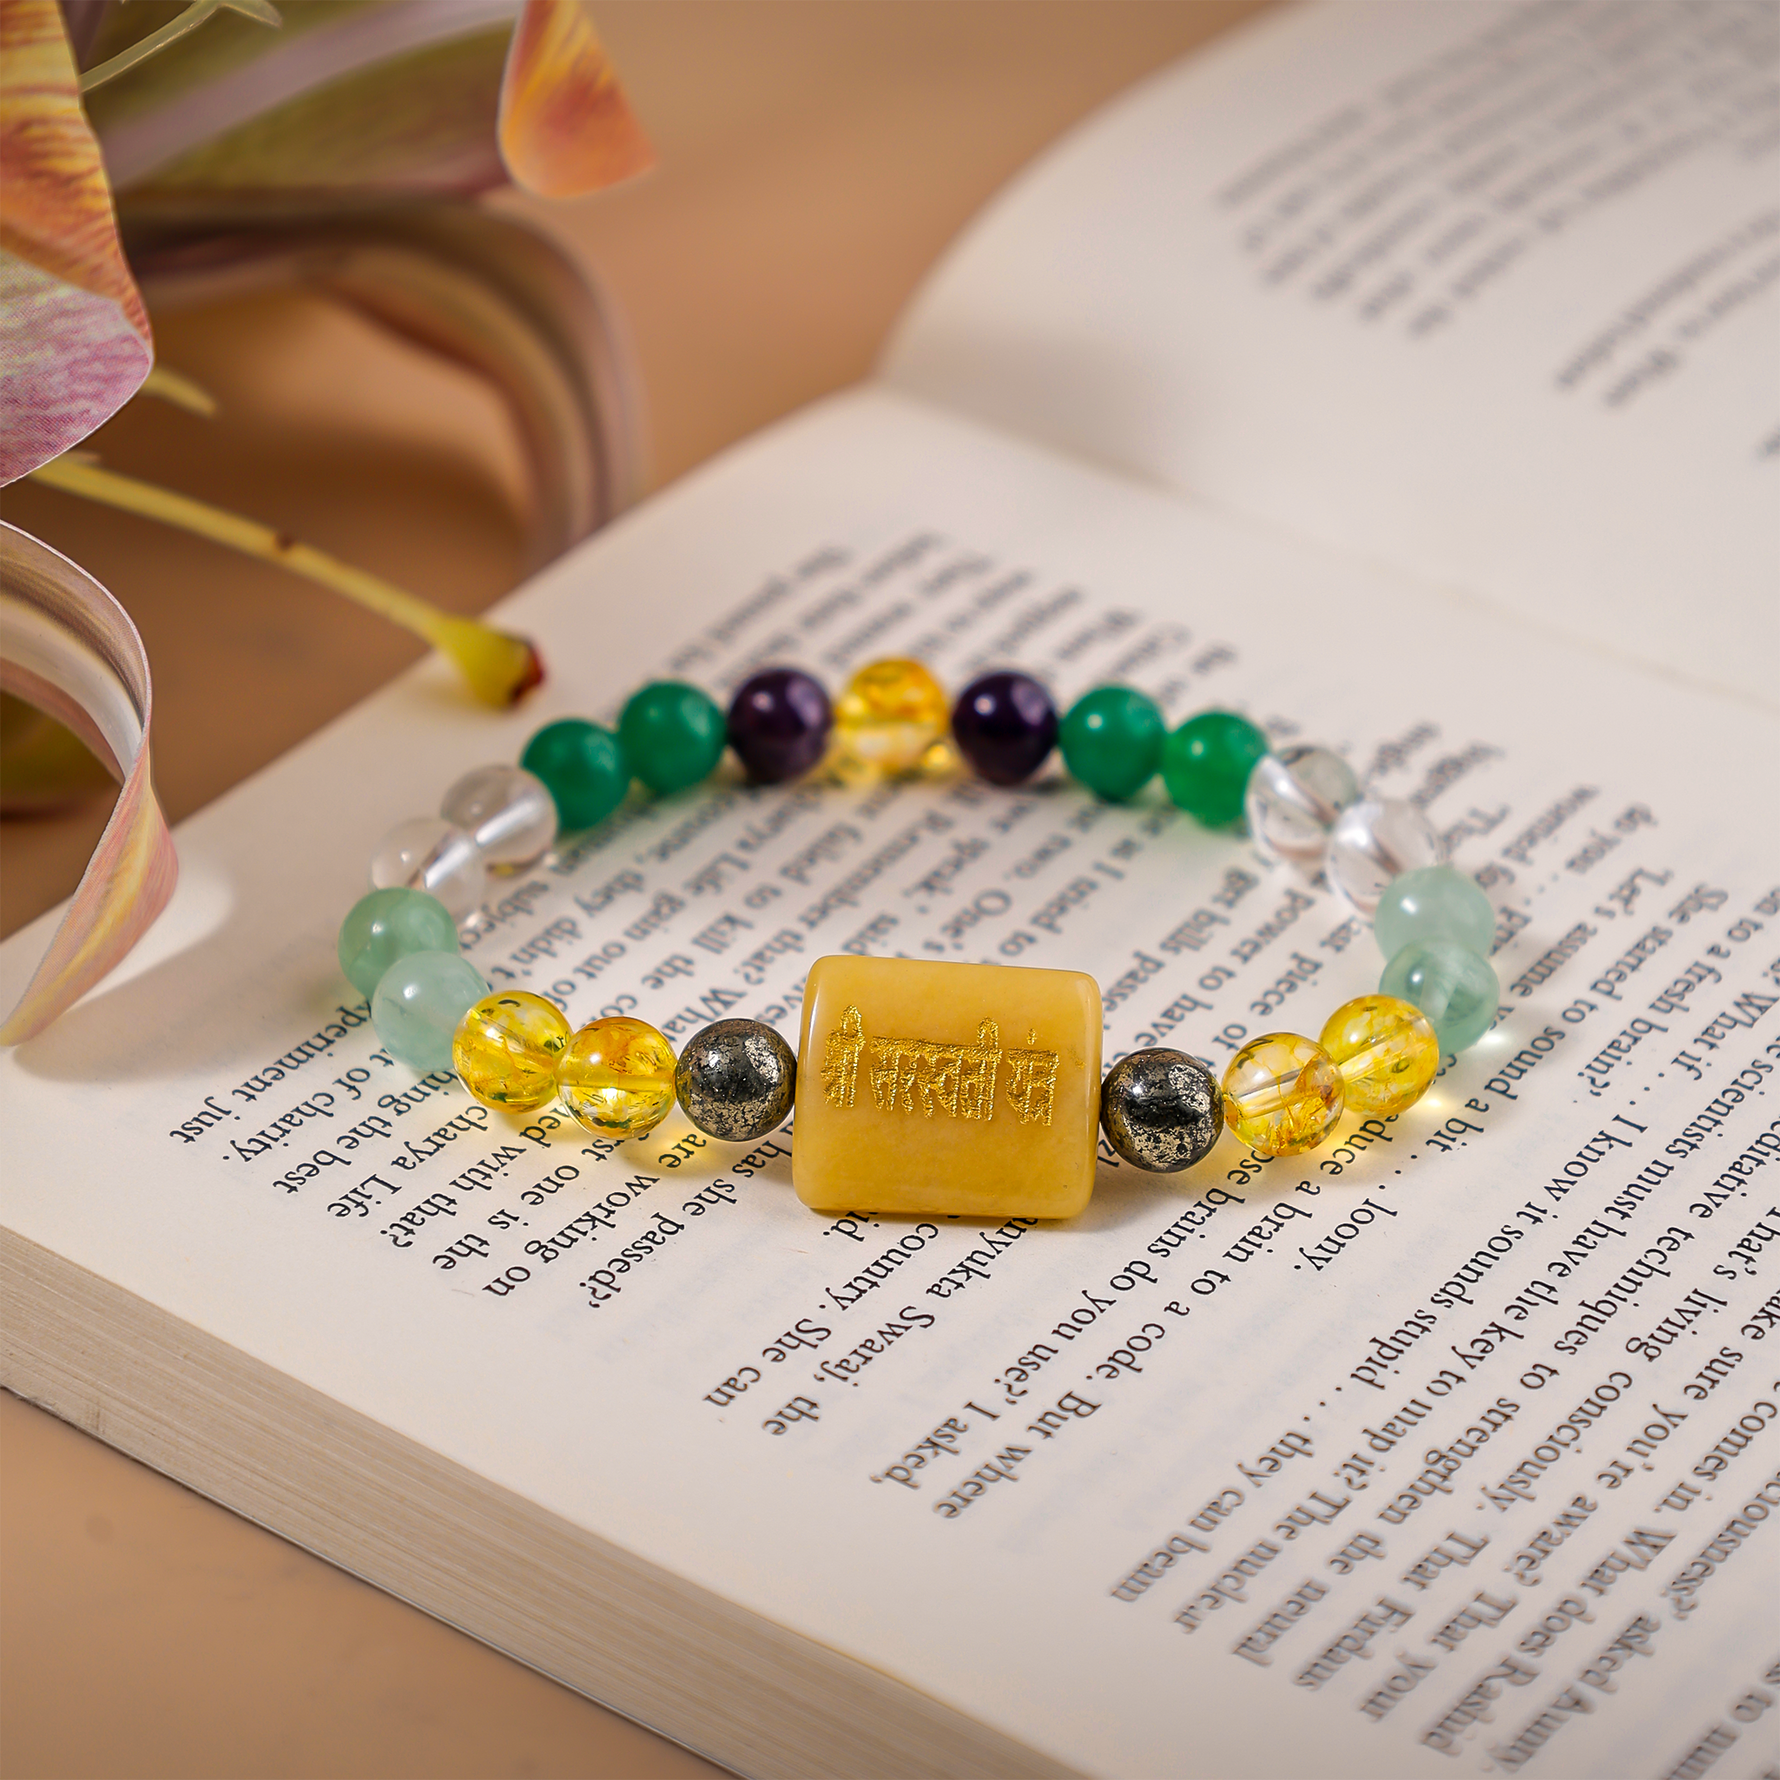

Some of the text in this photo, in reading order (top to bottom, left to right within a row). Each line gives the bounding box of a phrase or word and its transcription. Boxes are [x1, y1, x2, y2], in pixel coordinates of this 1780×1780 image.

[743, 882, 784, 910] to
[1667, 883, 1729, 925] She
[491, 917, 583, 980] didn't
[691, 911, 754, 955] kill
[733, 928, 805, 986] that?
[841, 913, 899, 955] said
[999, 931, 1037, 957] to
[1158, 907, 1231, 956] bills
[572, 941, 628, 981] out
[641, 953, 695, 990] the
[1249, 951, 1324, 1017] piece
[1508, 922, 1597, 998] assume
[1589, 925, 1674, 1001] started
[541, 979, 577, 1013] of
[661, 988, 746, 1042] What
[1101, 951, 1166, 1029] passe
[1560, 999, 1599, 1025] to
[1577, 917, 1764, 1097] to a fresh brain?'
[1212, 1024, 1248, 1051] of
[1692, 992, 1780, 1051] What
[231, 1000, 372, 1103] xperiment
[1483, 1025, 1566, 1101] sound
[1670, 1050, 1712, 1081] if
[332, 1067, 371, 1101] of
[1464, 1097, 1490, 1113] a
[1664, 1059, 1774, 1159] scientists
[169, 1096, 241, 1144] just
[222, 1092, 335, 1163] charity.
[336, 1115, 393, 1150] the
[390, 1106, 488, 1171] charya
[1320, 1113, 1399, 1176] duce
[1425, 1117, 1485, 1153] bit
[1611, 1114, 1646, 1132] I
[272, 1149, 352, 1194] best
[448, 1145, 527, 1191] with
[657, 1133, 707, 1169] are
[703, 888, 1316, 1407] power to have country. She can
[731, 1140, 793, 1178] has
[1226, 1149, 1276, 1186] ose
[1543, 1129, 1633, 1202] know
[327, 1173, 403, 1218] Life
[520, 1165, 580, 1206] one
[682, 1178, 738, 1216] she
[1294, 1180, 1321, 1196] a
[1603, 1159, 1675, 1221] must
[379, 1193, 458, 1248] that?
[487, 1208, 529, 1230] is
[524, 1175, 661, 1264] working
[1147, 1187, 1246, 1258] brains
[1222, 1202, 1313, 1263] brain
[1293, 1197, 1398, 1272] loony.
[1516, 1201, 1559, 1225] it
[432, 1233, 490, 1270] the
[579, 1211, 685, 1309] passed?'
[926, 1216, 1038, 1298] anyukta
[1430, 1224, 1524, 1309] sounds
[1547, 1219, 1627, 1278] have
[481, 1266, 531, 1297] on
[1109, 1260, 1158, 1292] do
[1190, 1269, 1232, 1296] to
[1504, 1280, 1559, 1321] the
[1051, 1289, 1117, 1341] you
[1163, 1301, 1191, 1317] a
[1625, 1287, 1728, 1363] living
[813, 1305, 936, 1387] Swaraj,
[1085, 1323, 1166, 1380] code.
[1350, 1309, 1438, 1390] stupid
[1450, 1321, 1525, 1370] key
[994, 1343, 1059, 1405] use?'
[1231, 1120, 1780, 1668] ditative techniques to strengthen the neural
[1426, 1370, 1467, 1397] to
[763, 1396, 820, 1436] the
[963, 1401, 995, 1419] I
[1027, 1390, 1102, 1440] But
[1361, 1398, 1433, 1453] map
[870, 1417, 969, 1490] asked,
[1237, 1431, 1314, 1488] they
[1477, 1371, 1633, 1513] consciously.
[936, 1446, 1033, 1519] where
[1333, 1453, 1385, 1491] it?
[1188, 1489, 1245, 1533] can
[1275, 1491, 1352, 1541] The
[1359, 1289, 1780, 1723] ake sure you're aware? That your
[1110, 1535, 1210, 1603] beam
[1401, 1531, 1490, 1591] That
[1661, 1471, 1780, 1621] ciousness?'
[1420, 1401, 1778, 1756] comes in. What does Rashid
[1296, 1598, 1414, 1687] Firdaus
[1578, 1615, 1660, 1694] asked
[1732, 1691, 1774, 1724] to
